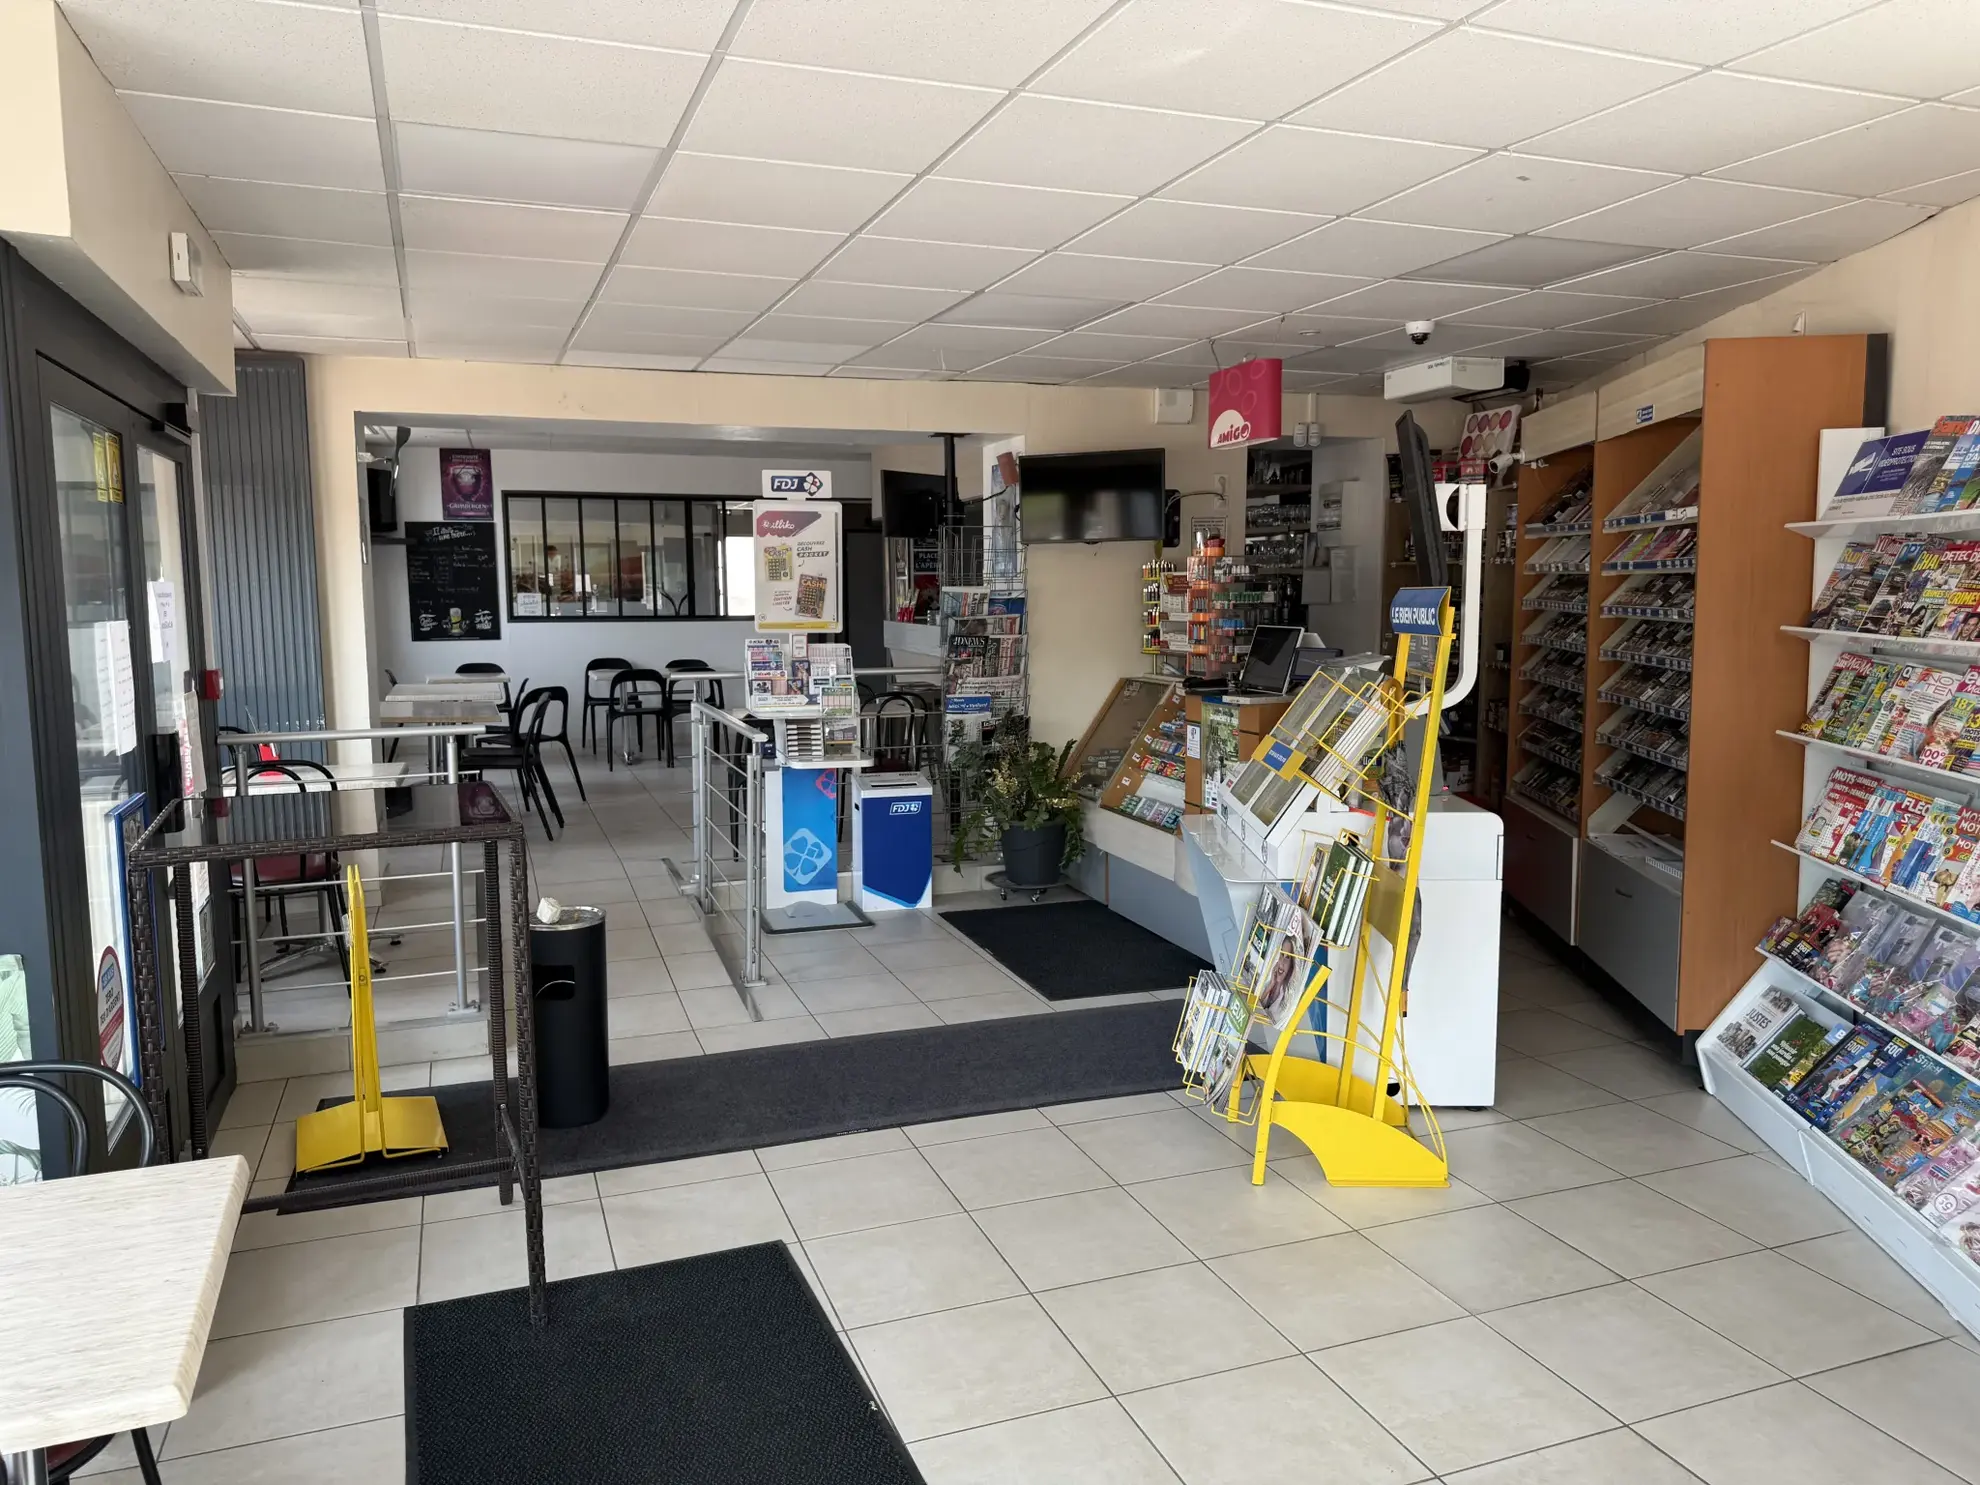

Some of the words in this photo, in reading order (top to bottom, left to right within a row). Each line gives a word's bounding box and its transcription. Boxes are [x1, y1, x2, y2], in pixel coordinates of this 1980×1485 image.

[773, 478, 798, 490] FDJ
[1391, 607, 1400, 624] LE
[1400, 607, 1413, 624] BIEN
[1413, 608, 1436, 626] PUBLIC
[1953, 697, 1977, 711] 187
[1833, 769, 1856, 785] MOTS
[892, 804, 910, 813] FDJ
[1746, 1007, 1772, 1030] JUSTES
[1844, 1040, 1866, 1056] FOOT
